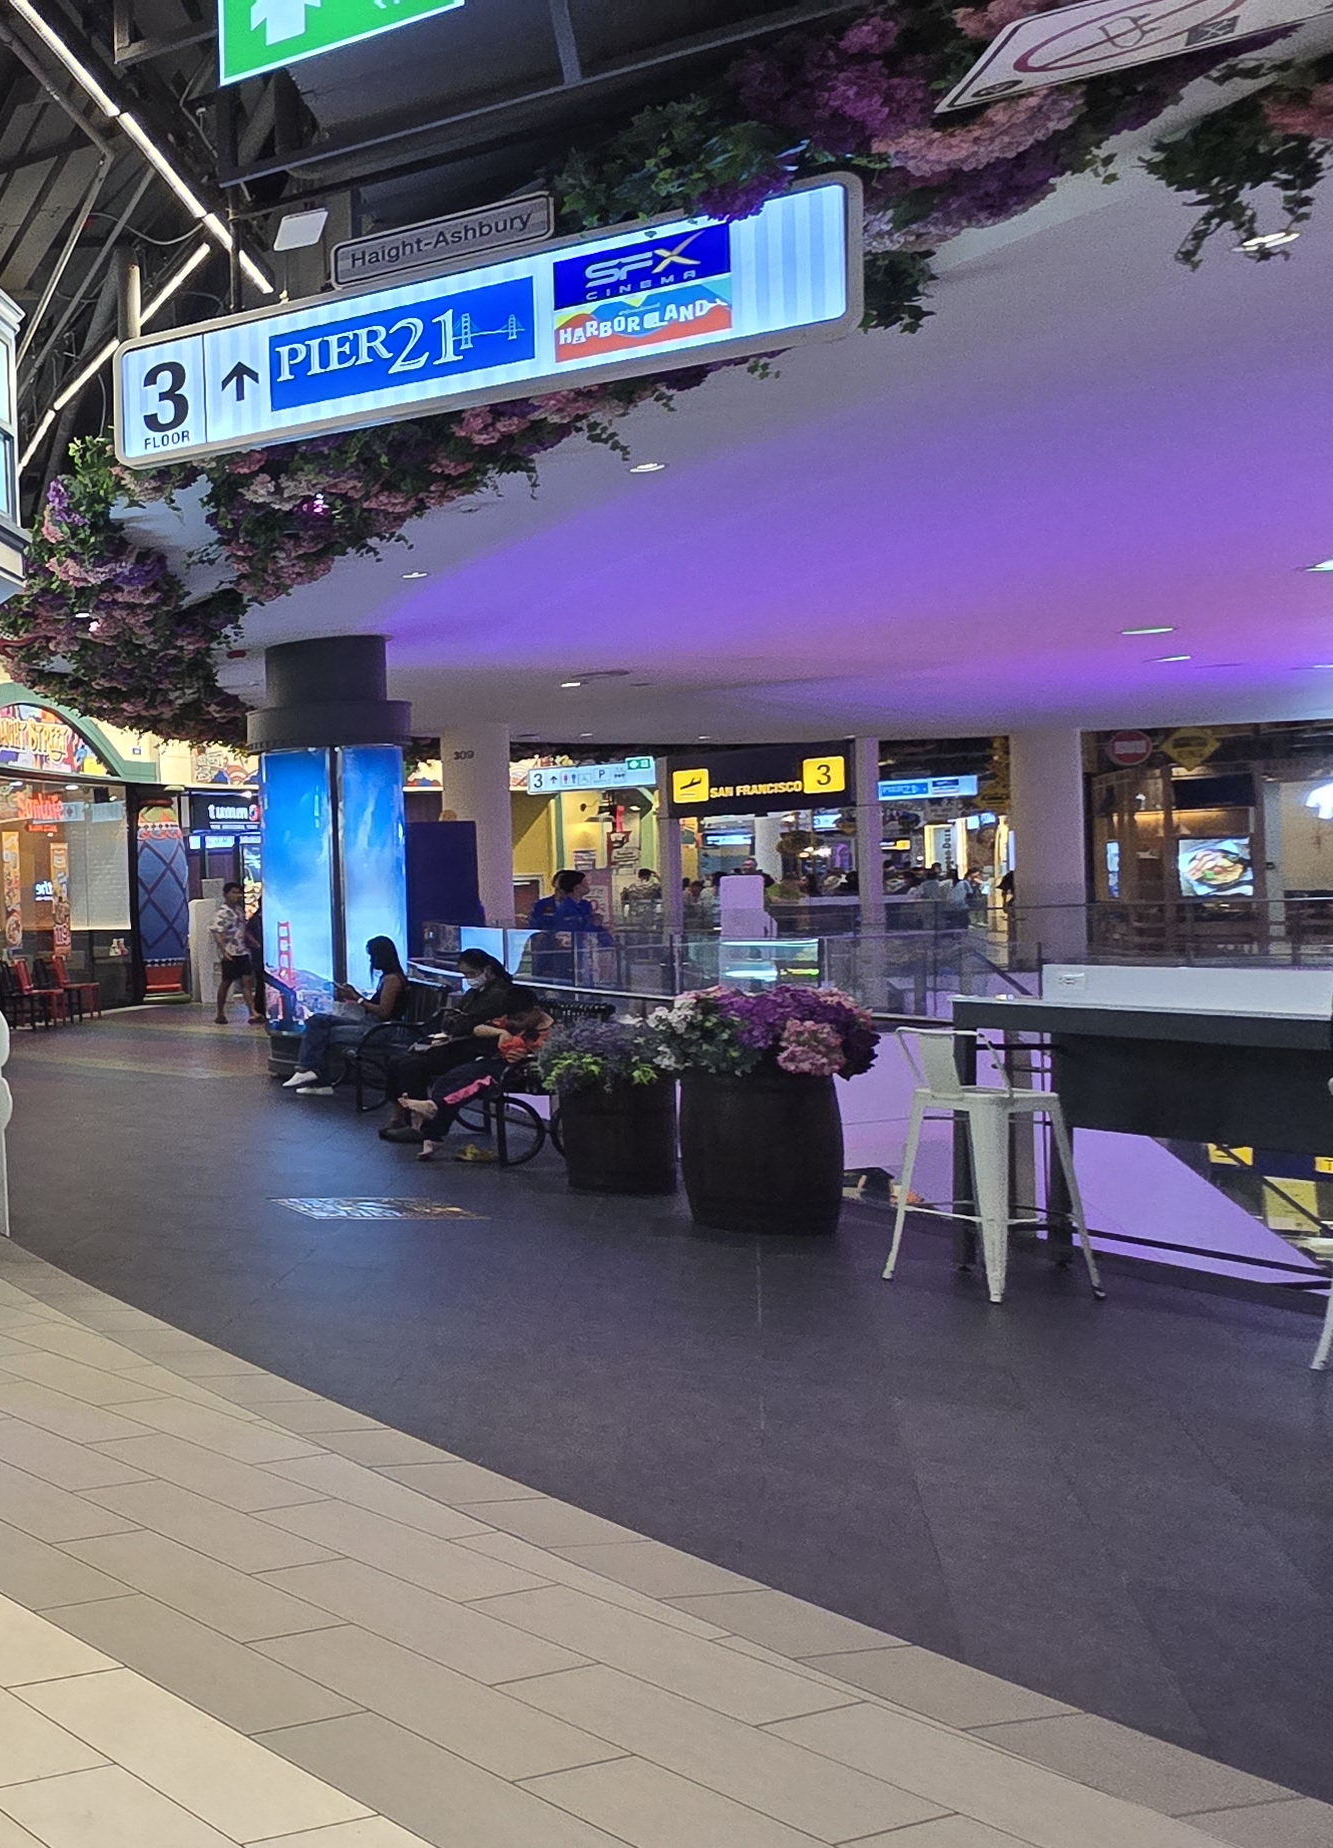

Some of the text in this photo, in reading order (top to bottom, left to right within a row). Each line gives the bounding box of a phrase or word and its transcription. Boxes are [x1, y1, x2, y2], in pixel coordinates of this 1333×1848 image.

[350, 207, 533, 270] Haight-Ashbury
[587, 268, 697, 301] CINEMA
[559, 297, 730, 346] HARBORLAND
[143, 361, 189, 434] 3
[144, 430, 192, 451] FLOOR
[29, 718, 70, 762] STREET
[453, 749, 475, 761] 309
[533, 773, 544, 789] 3
[709, 763, 832, 799] SAN FRANCISCO 3
